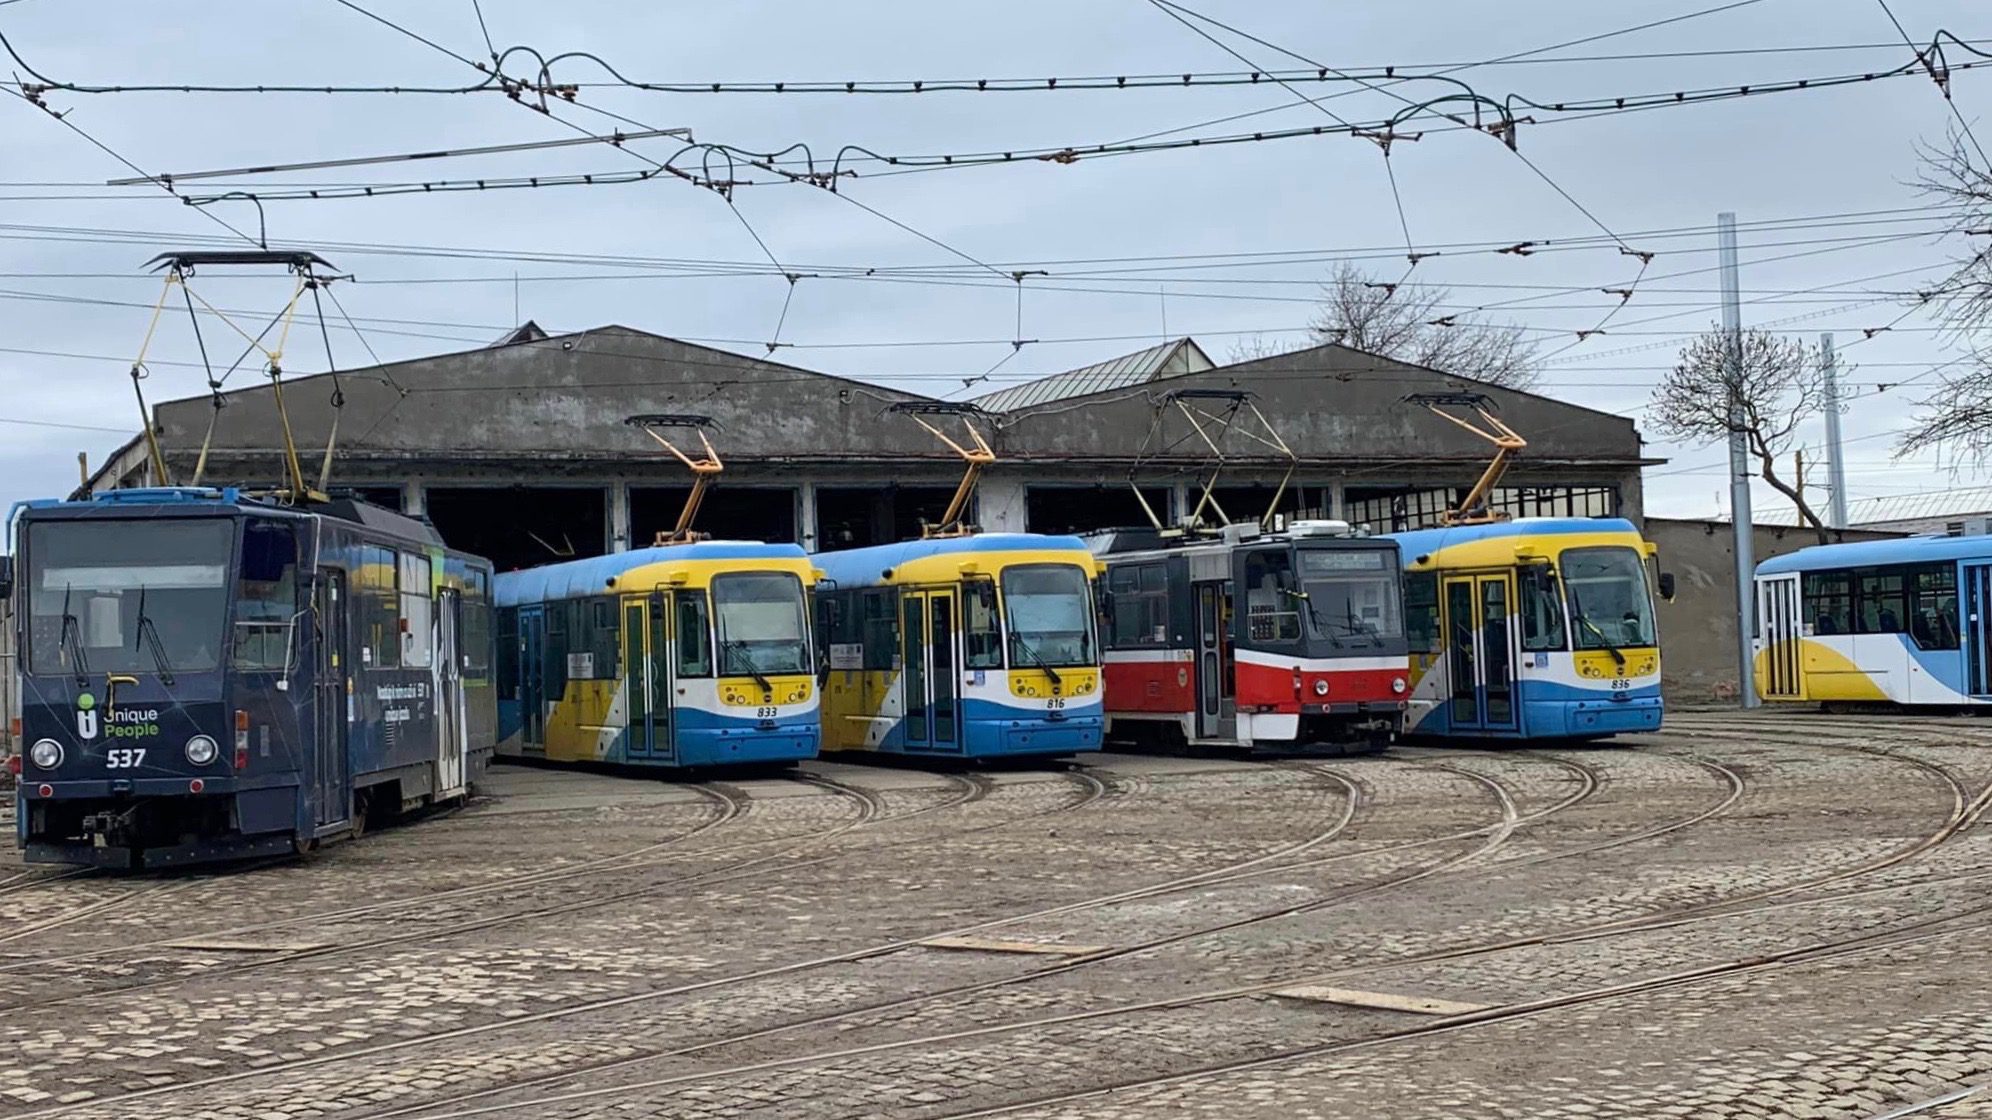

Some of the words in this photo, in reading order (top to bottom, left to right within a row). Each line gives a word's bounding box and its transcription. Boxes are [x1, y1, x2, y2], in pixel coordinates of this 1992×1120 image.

[1047, 698, 1065, 709] 816
[757, 707, 777, 718] 833
[104, 723, 159, 739] People
[106, 748, 146, 769] 537
